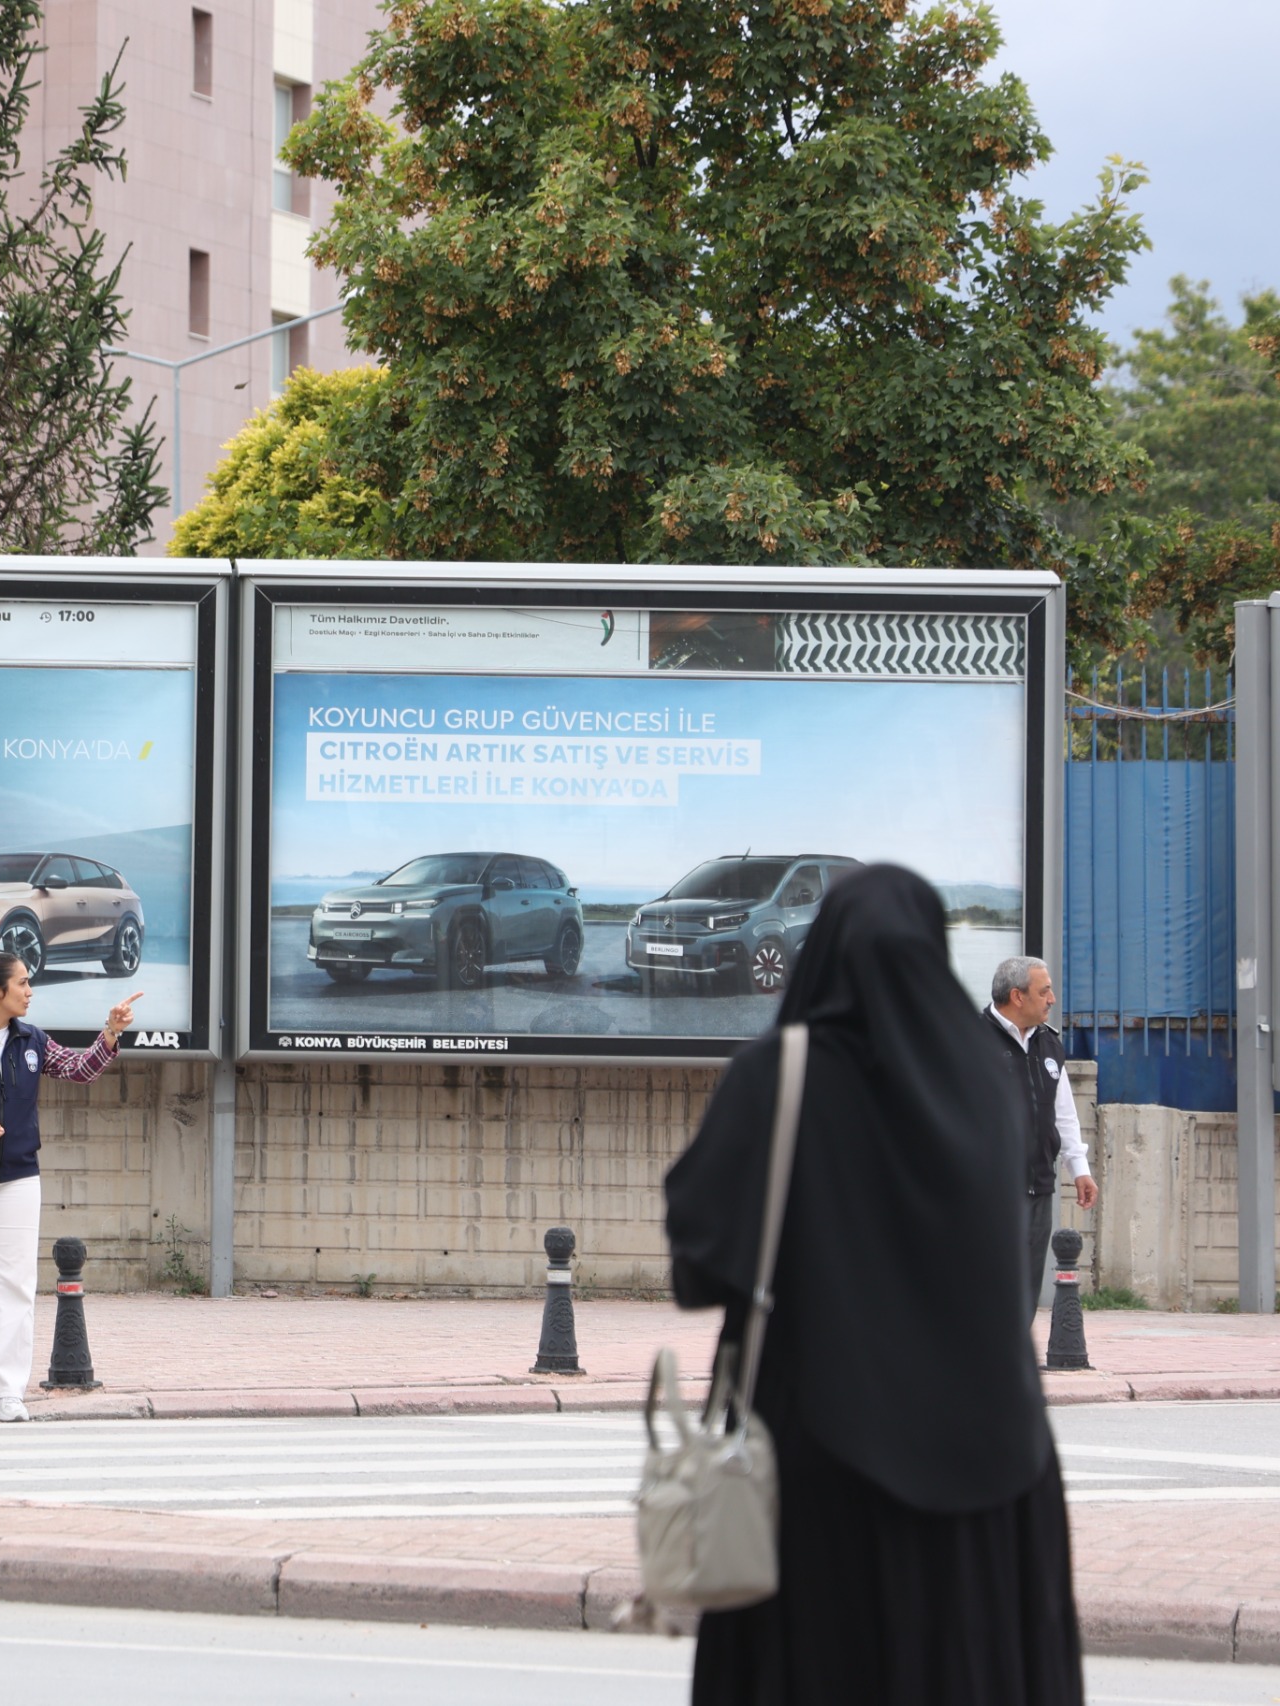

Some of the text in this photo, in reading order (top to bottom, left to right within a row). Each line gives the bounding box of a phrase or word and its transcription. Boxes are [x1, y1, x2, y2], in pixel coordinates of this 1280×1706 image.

[58, 610, 95, 622] 17:00
[309, 614, 450, 625] Tüm Halkımız Davetlidir.
[309, 705, 716, 733] KOYUNCU GRUP GÜVENCESİ İLE
[4, 737, 131, 761] KONYA'DA
[320, 737, 750, 770] CITROËN ARTIK SATIŞ VE SERVİS
[319, 769, 668, 799] HİZMETLERİ İLE KONYA'DA
[134, 1031, 180, 1049] AAR
[295, 1036, 508, 1051] KONYA BÜYÜKŞEHİR BELEDİYESİ
